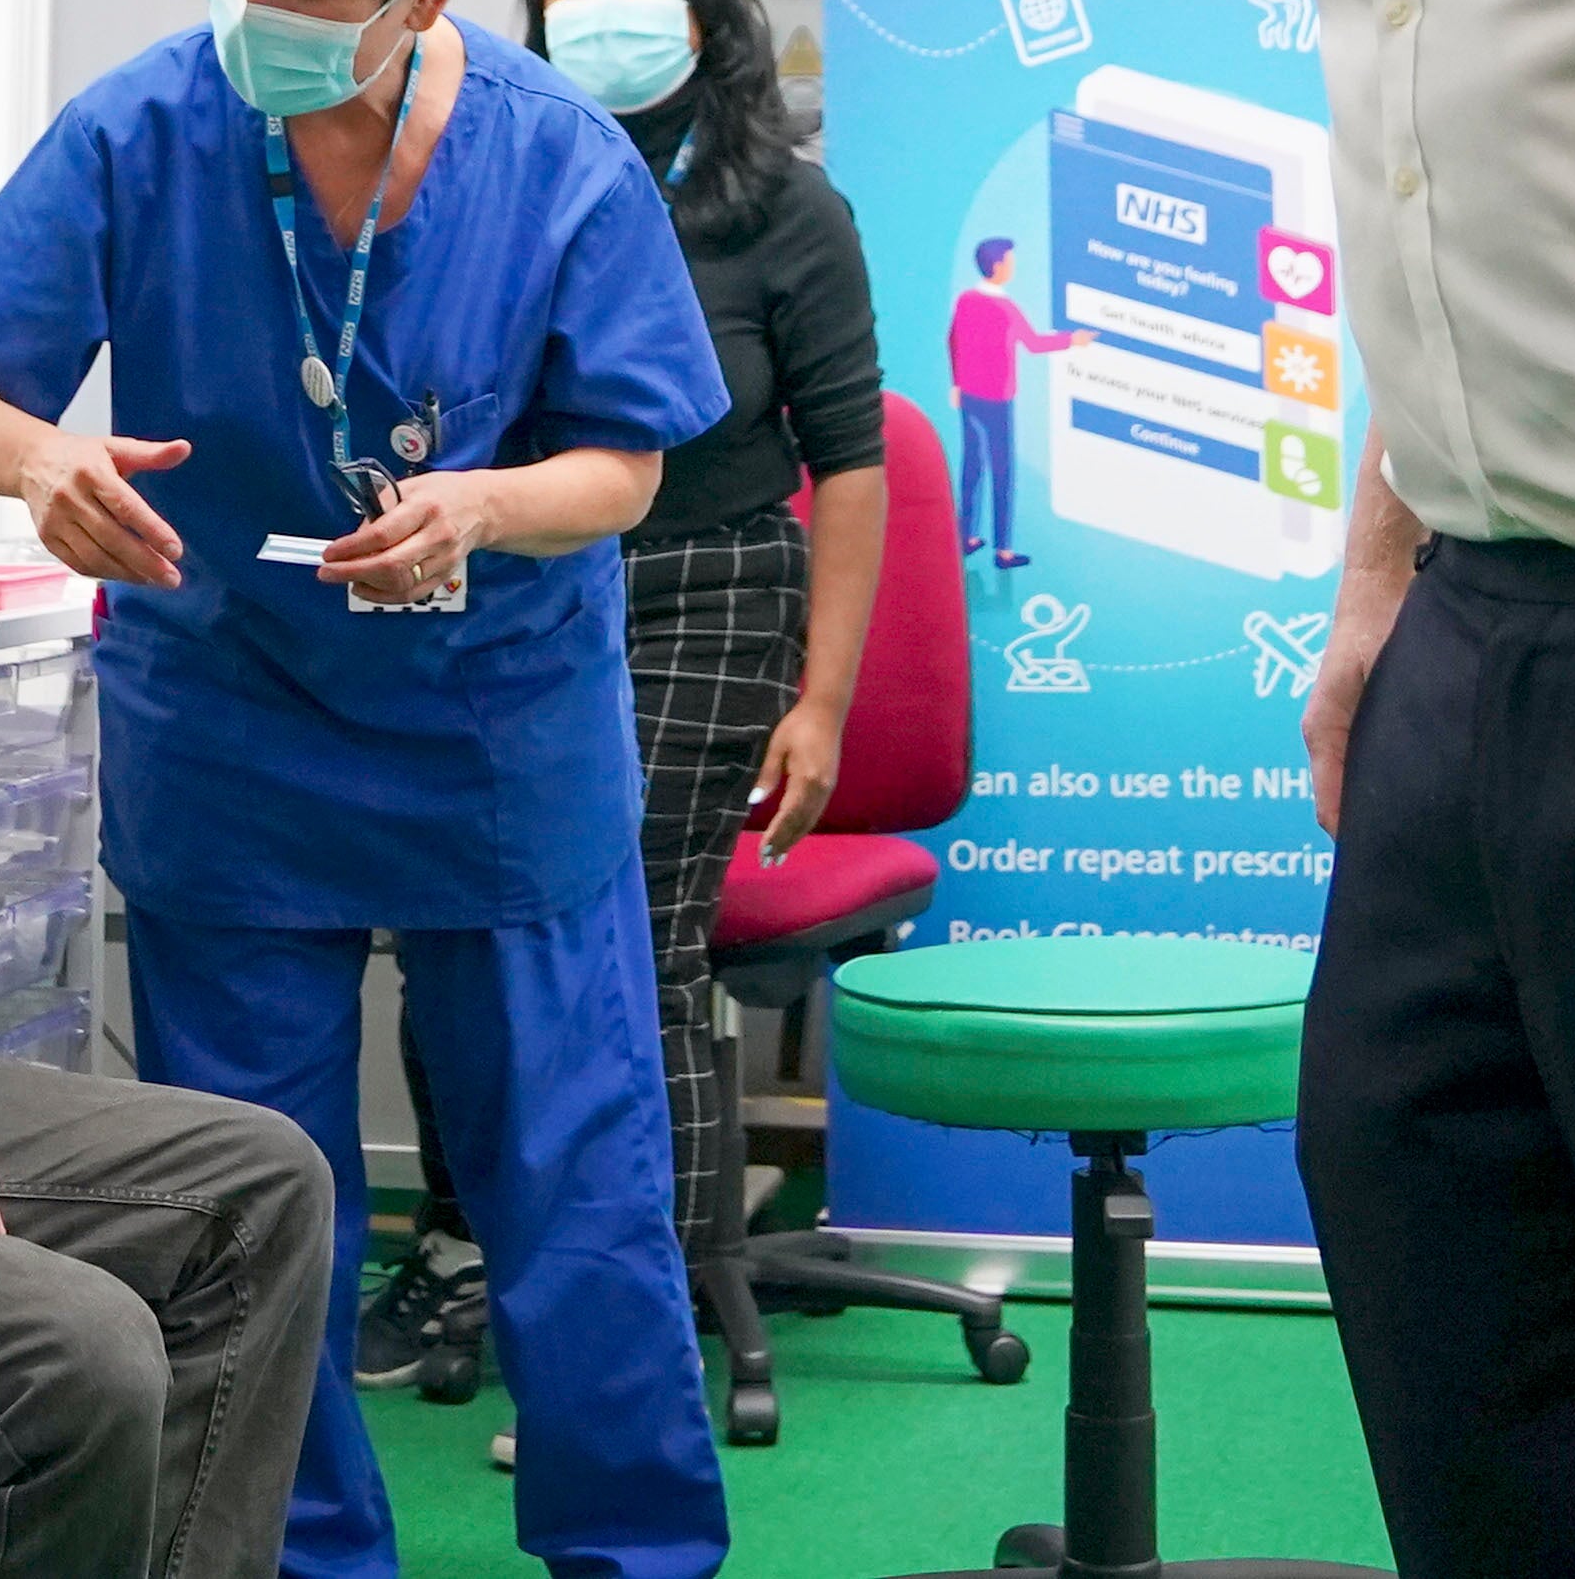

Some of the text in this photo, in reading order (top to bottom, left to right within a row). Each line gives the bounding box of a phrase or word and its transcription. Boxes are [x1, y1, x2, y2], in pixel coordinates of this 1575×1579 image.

[1124, 192, 1199, 236] NHS
[1087, 238, 1125, 262] How
[1126, 252, 1152, 270] are
[1184, 265, 1239, 298] feeling
[1136, 270, 1190, 298] today?
[348, 270, 365, 305] NHS
[340, 322, 356, 357] NHS
[1130, 423, 1201, 457] Continue
[971, 770, 1017, 797] an
[1028, 763, 1100, 798] also
[1110, 771, 1170, 799] use
[1180, 765, 1243, 800] the
[948, 838, 1335, 885] Order repeat prescrip
